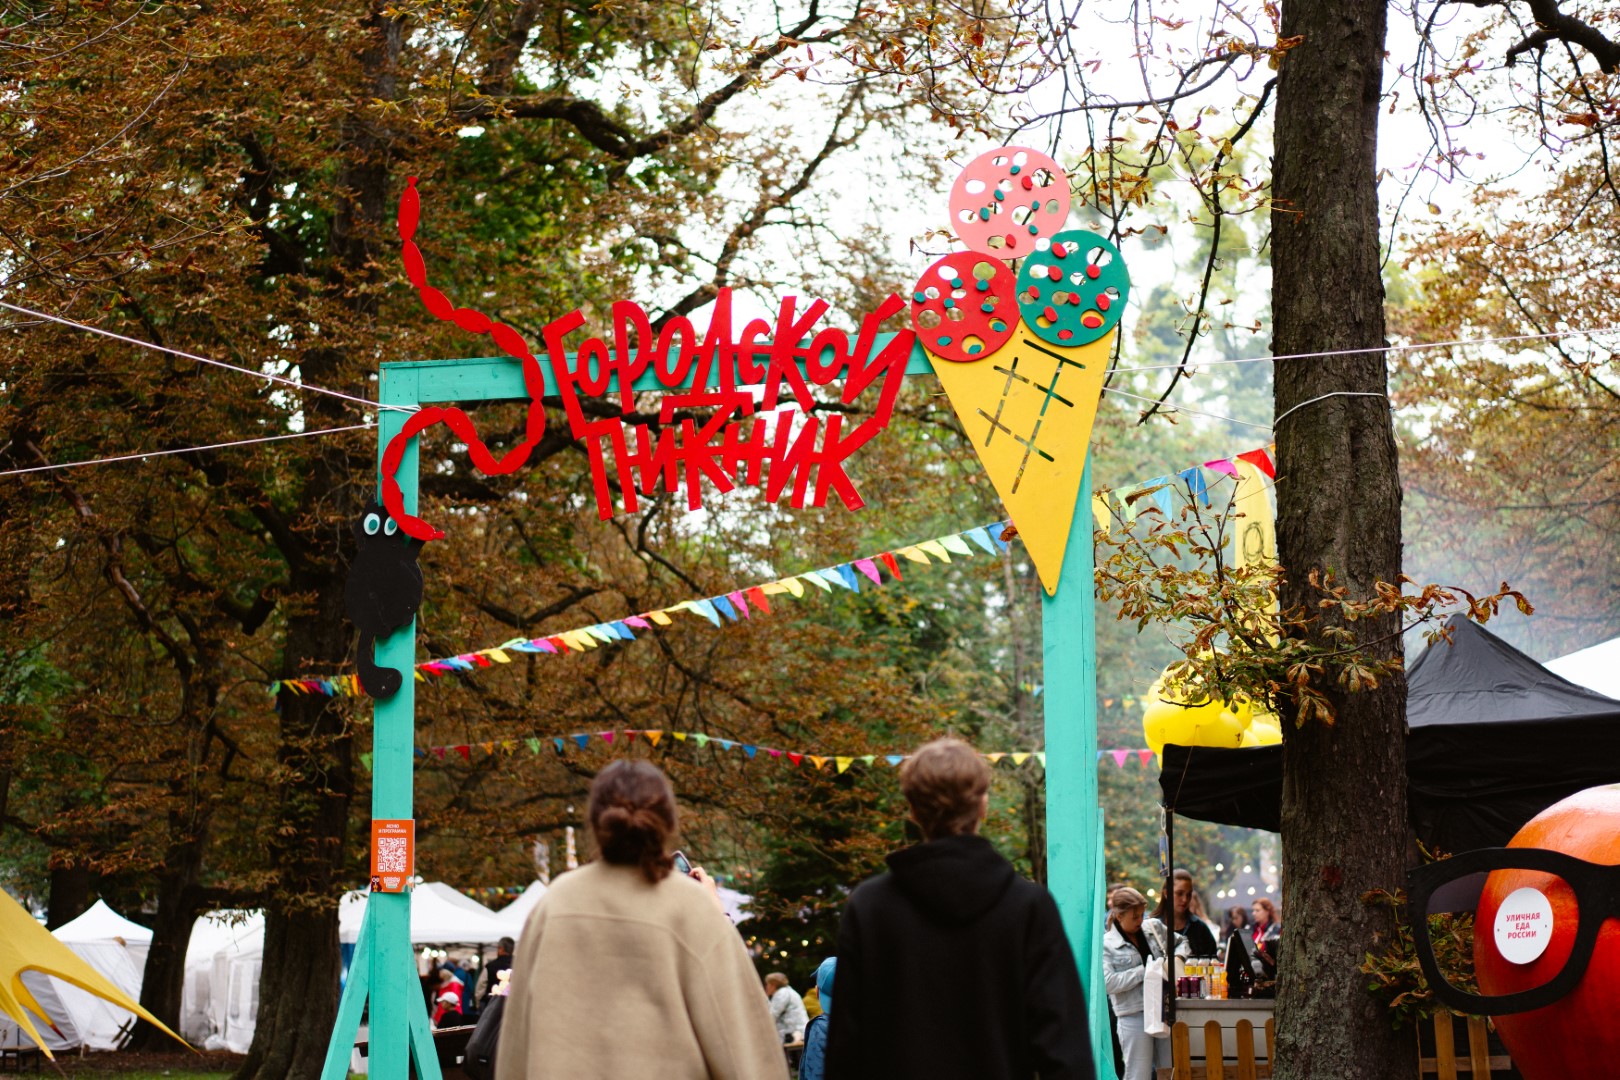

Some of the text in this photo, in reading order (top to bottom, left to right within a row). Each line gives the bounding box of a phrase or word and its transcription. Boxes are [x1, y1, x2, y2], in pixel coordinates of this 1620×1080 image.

[585, 401, 881, 521] ПИКНИК
[1506, 912, 1541, 922] УЛИЧНАЯ
[1515, 922, 1530, 931] ЕДА
[1507, 930, 1537, 939] РОССИИ
